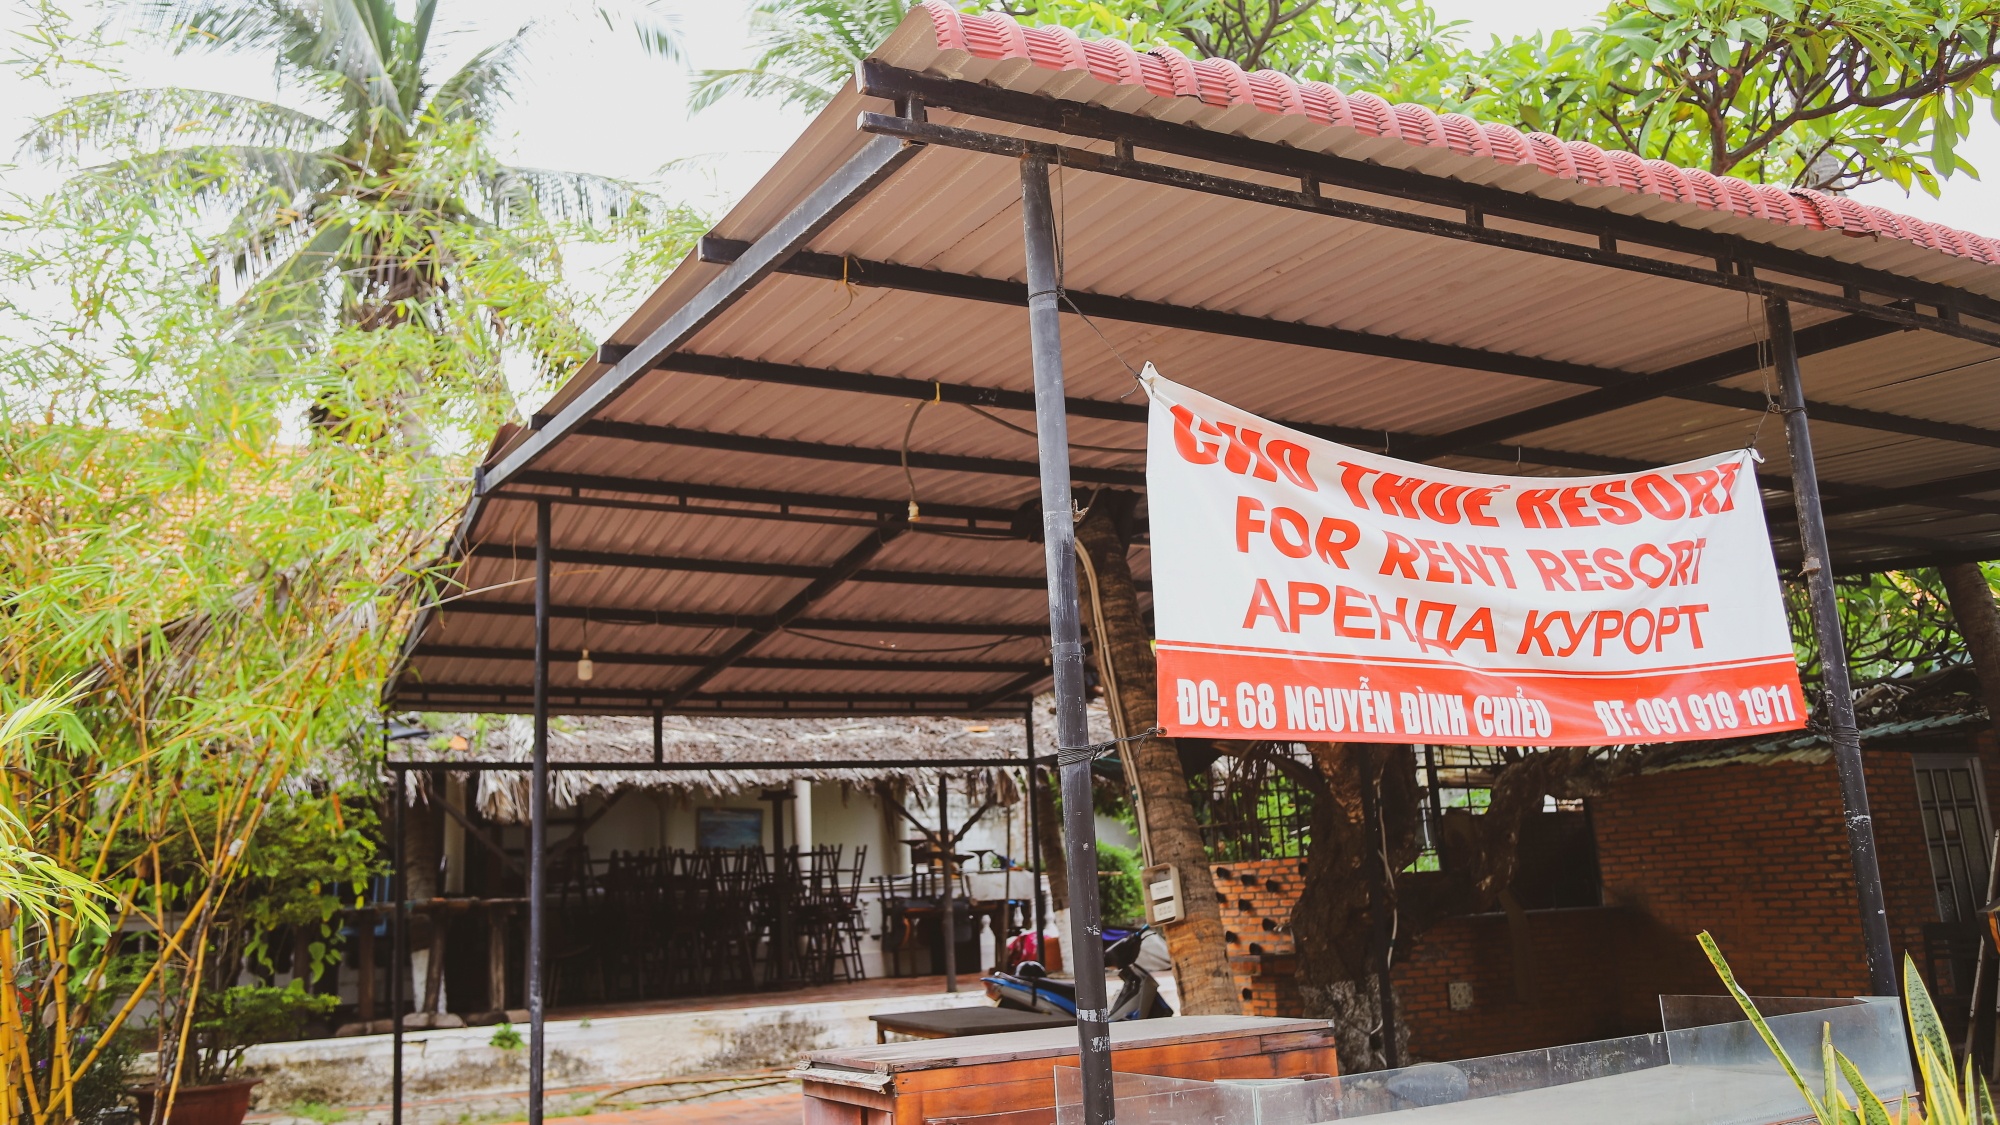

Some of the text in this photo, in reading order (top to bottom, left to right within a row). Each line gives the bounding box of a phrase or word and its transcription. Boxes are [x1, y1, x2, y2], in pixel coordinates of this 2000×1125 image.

[1170, 404, 1319, 492] CHO
[1516, 462, 1741, 529] RESORT
[1235, 495, 1707, 592] FOR RENT RESORT
[1242, 578, 1710, 657] АРЕНДА КУРОРТ
[1176, 678, 1229, 727] ĐC:
[1236, 682, 1277, 730] 68
[1284, 676, 1396, 733] NGUYỄN
[1400, 685, 1469, 736] ĐÌNH
[1473, 685, 1552, 738] CHIỂU
[1635, 696, 1690, 736] 091
[1687, 691, 1739, 732] 919
[1739, 684, 1796, 727] 1911
